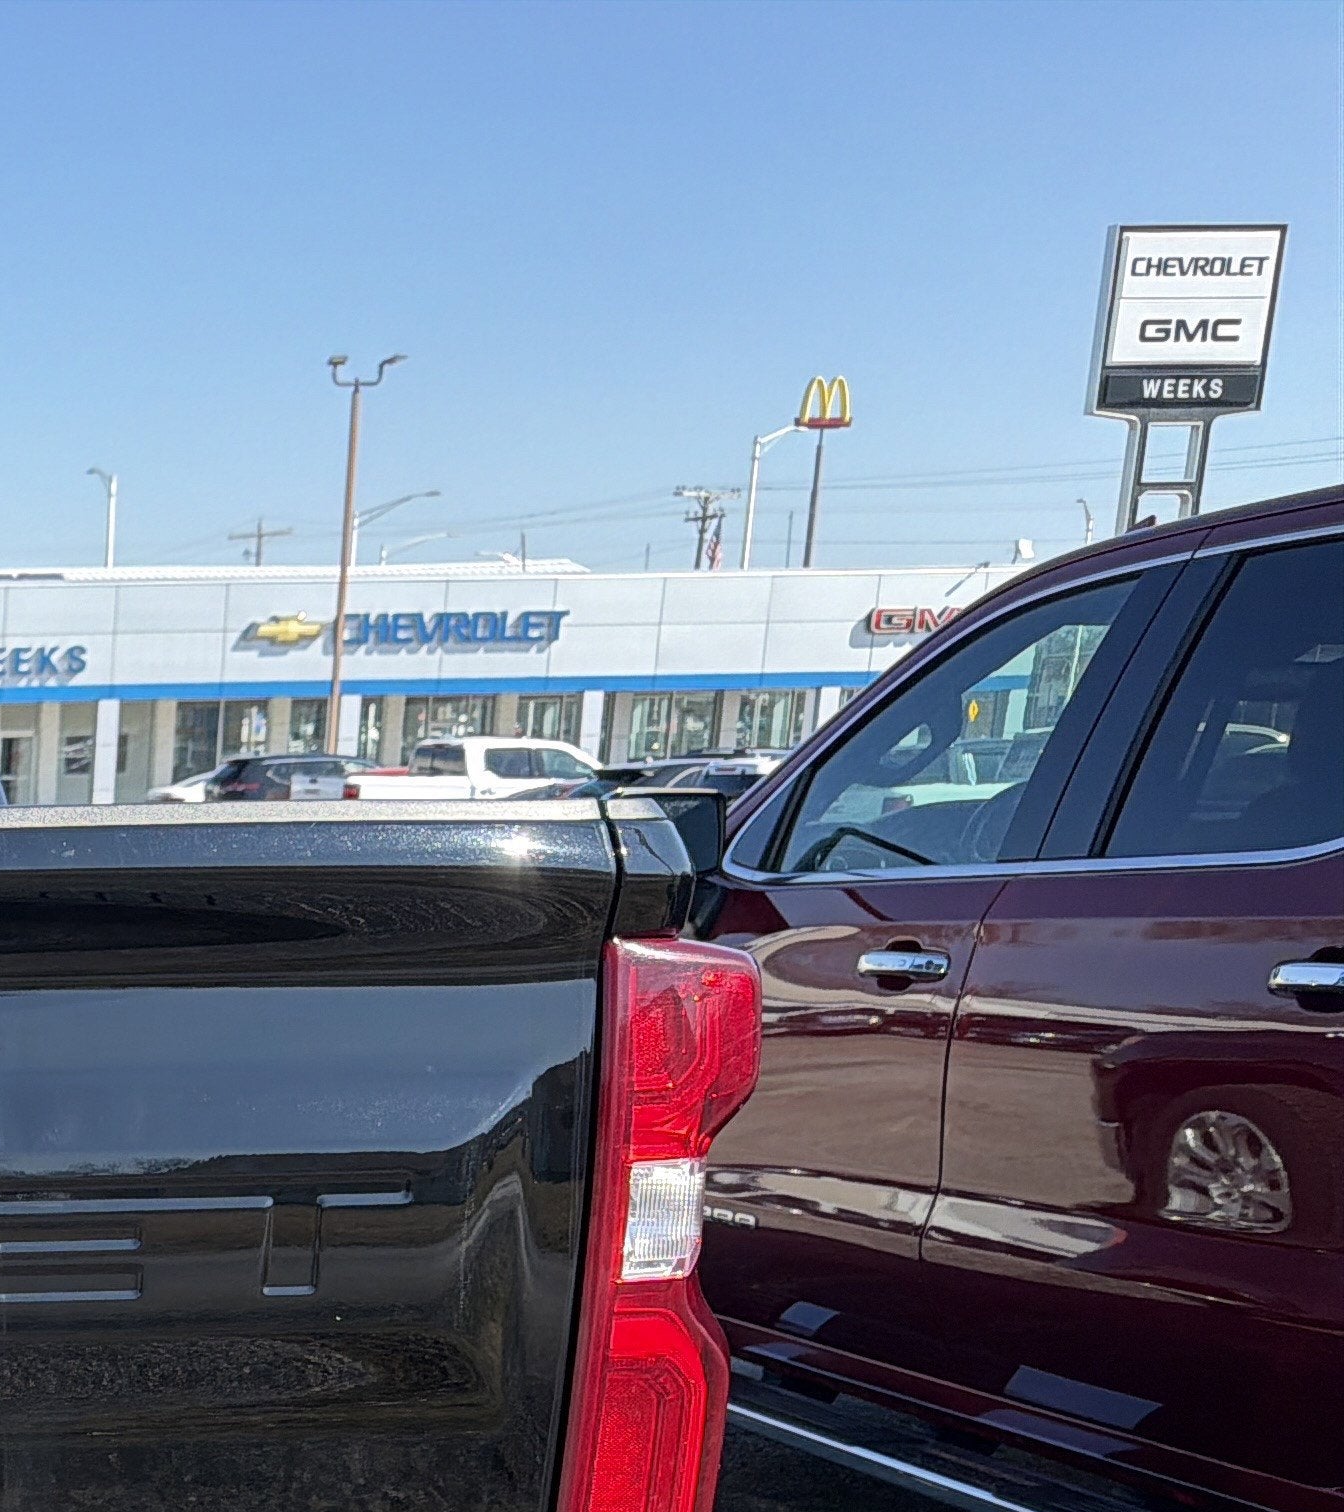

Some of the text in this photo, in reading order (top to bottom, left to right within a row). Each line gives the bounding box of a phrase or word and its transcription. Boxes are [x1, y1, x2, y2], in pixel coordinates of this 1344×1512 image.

[1130, 256, 1270, 277] CHEVROLET
[1138, 318, 1242, 343] GMC
[1142, 378, 1224, 399] WEEKS
[871, 607, 962, 634] GM
